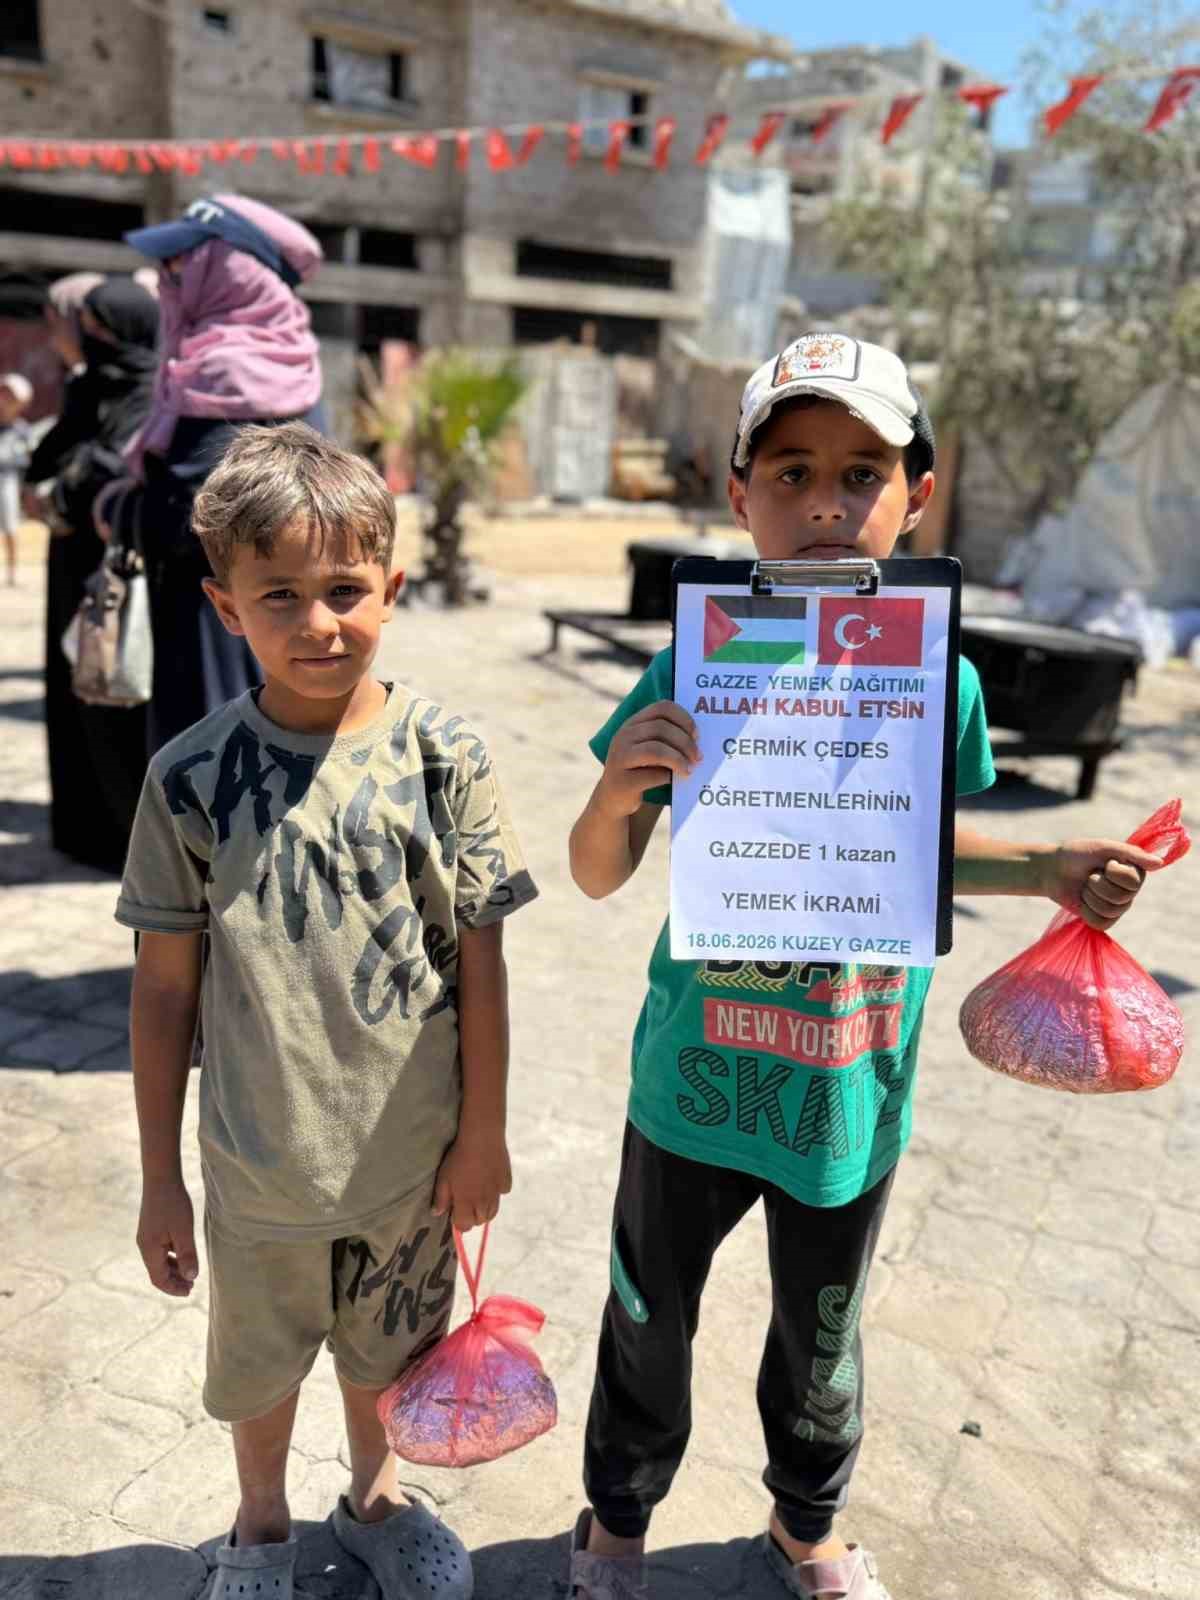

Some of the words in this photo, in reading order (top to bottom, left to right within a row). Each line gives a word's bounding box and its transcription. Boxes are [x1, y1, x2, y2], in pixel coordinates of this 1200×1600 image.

[695, 673, 758, 690] GAZZE
[767, 675, 833, 691] YEMEK
[840, 672, 925, 693] DAĞITIMI
[694, 696, 768, 716] ALLAH
[775, 697, 851, 718] KABUL
[858, 696, 925, 719] ETSİN
[722, 736, 807, 760] ÇERMİK
[814, 739, 889, 762] ÇEDES
[698, 784, 912, 812] ÖĞRETMENLERİNİN
[708, 840, 811, 860] GAZZEDE
[818, 844, 827, 861] 1
[836, 845, 896, 863] kazan
[721, 892, 797, 912] YEMEK
[803, 890, 881, 914] İKRAMİ
[687, 933, 777, 950] 18.06.2026
[782, 935, 844, 952] KUZEY
[849, 937, 912, 955] GAZZE
[716, 1004, 778, 1045] NEW
[787, 1015, 853, 1059] YORK
